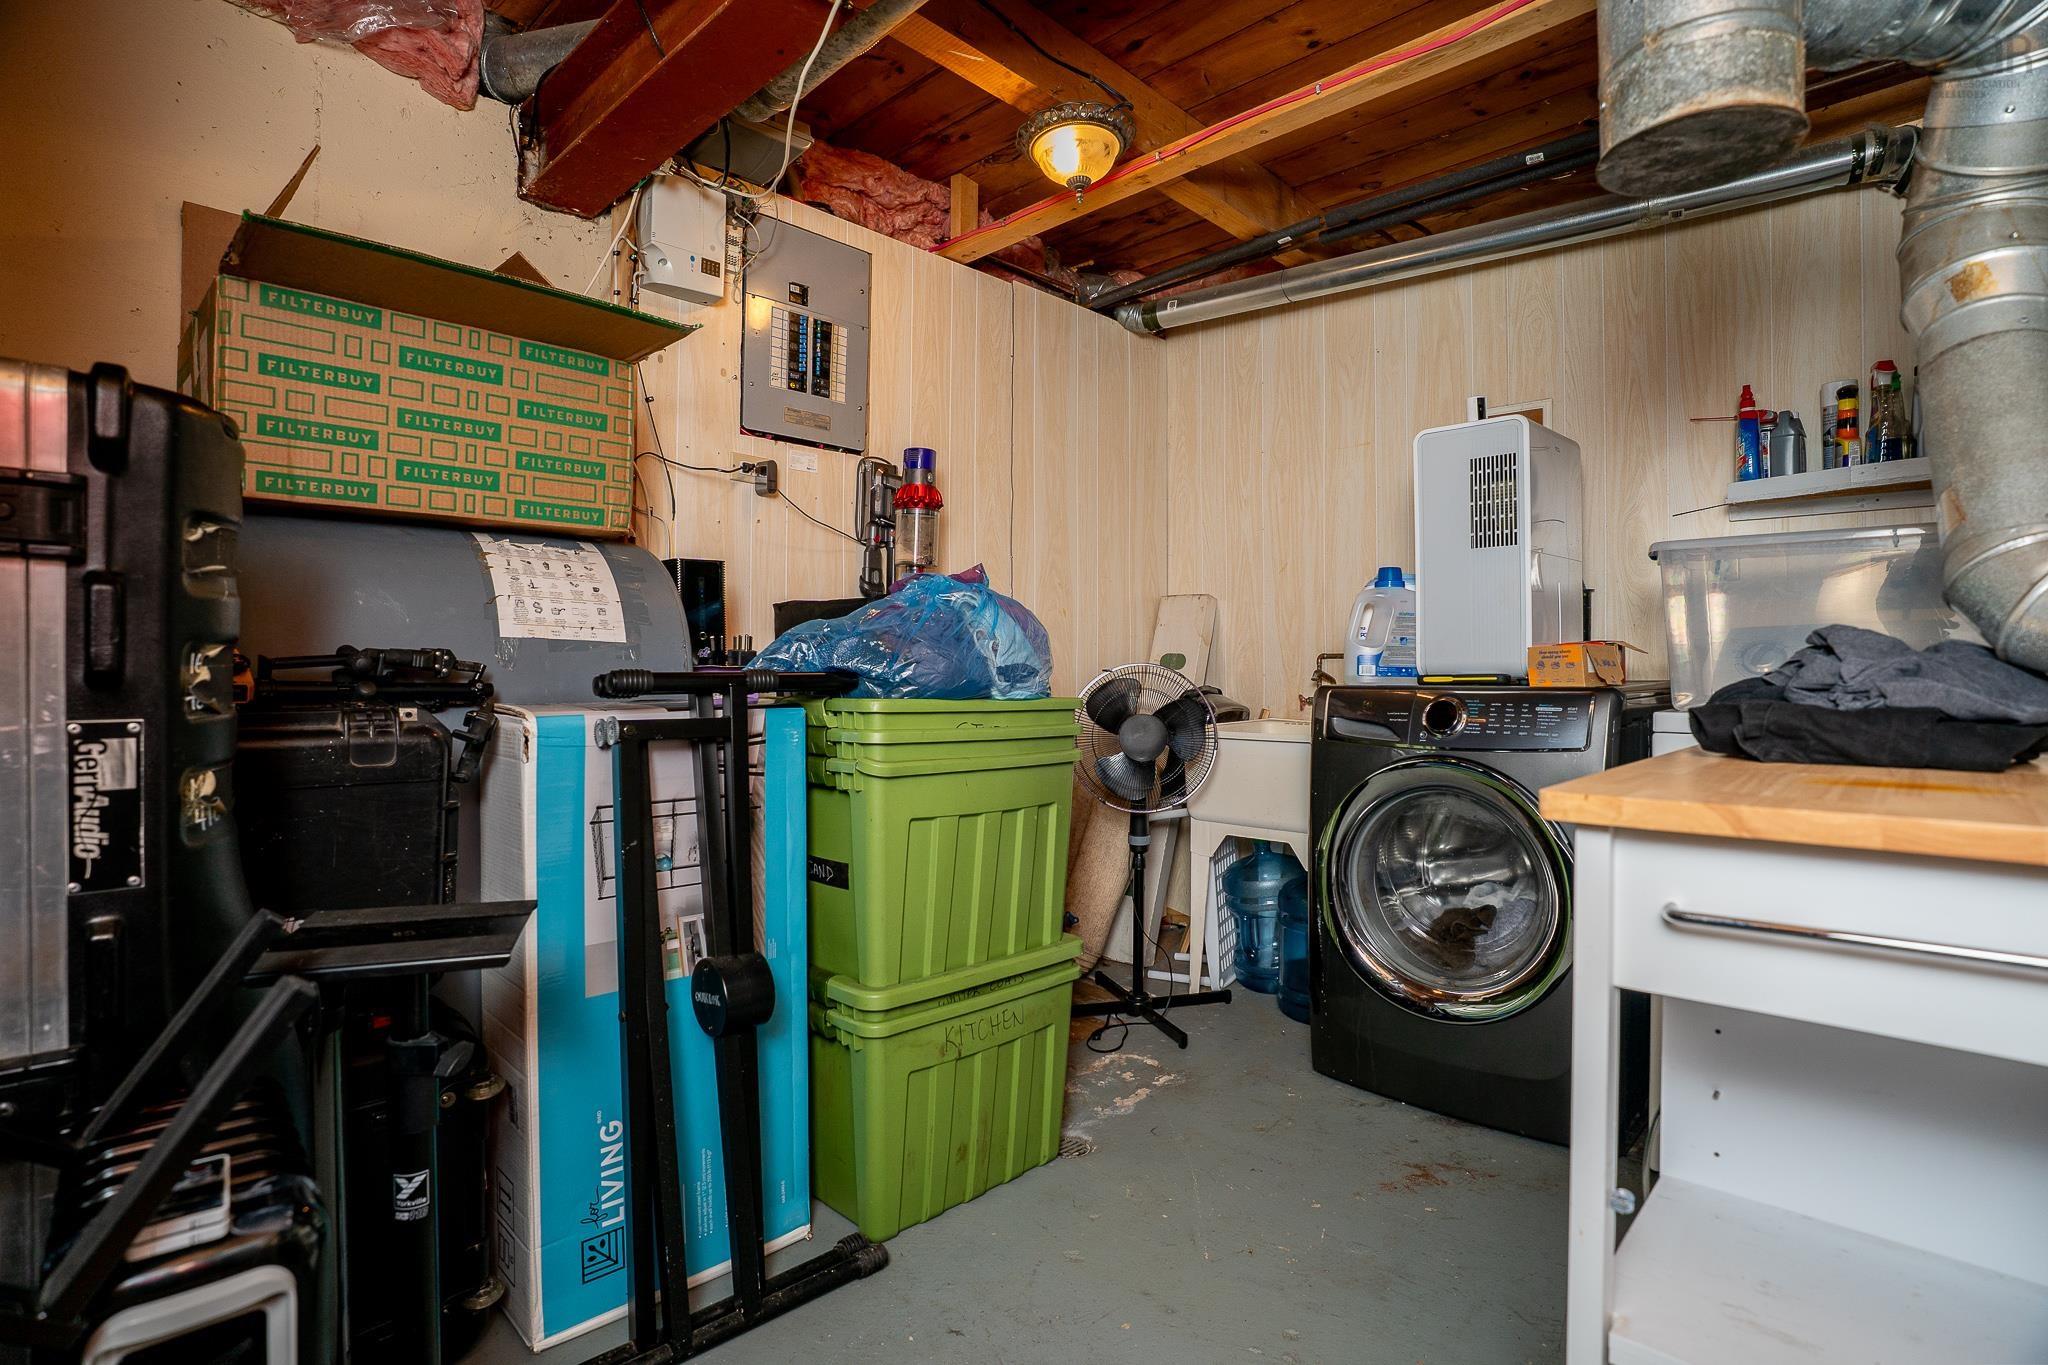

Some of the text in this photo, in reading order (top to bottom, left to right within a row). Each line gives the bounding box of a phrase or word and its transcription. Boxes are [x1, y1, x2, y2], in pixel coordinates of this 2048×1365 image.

[268, 291, 376, 324] FILTERBUY
[406, 351, 498, 379] FILTERBUY
[525, 345, 604, 372] FILTERBUY
[266, 359, 374, 388] FILTERBUY
[404, 413, 496, 437] FILTERBUY
[523, 404, 603, 427] FILTERBUY
[265, 420, 372, 445] FILTERBUY
[403, 465, 494, 486] FILTERBUY
[522, 456, 601, 476] FILTERBUY
[263, 476, 371, 498] FILTERBUY
[520, 504, 600, 522] FILTERBUY
[73, 739, 110, 860] GerrAudio
[944, 1003, 1024, 1056] KITCHEN
[599, 1119, 625, 1229] LIVING
[580, 1185, 609, 1230] for
